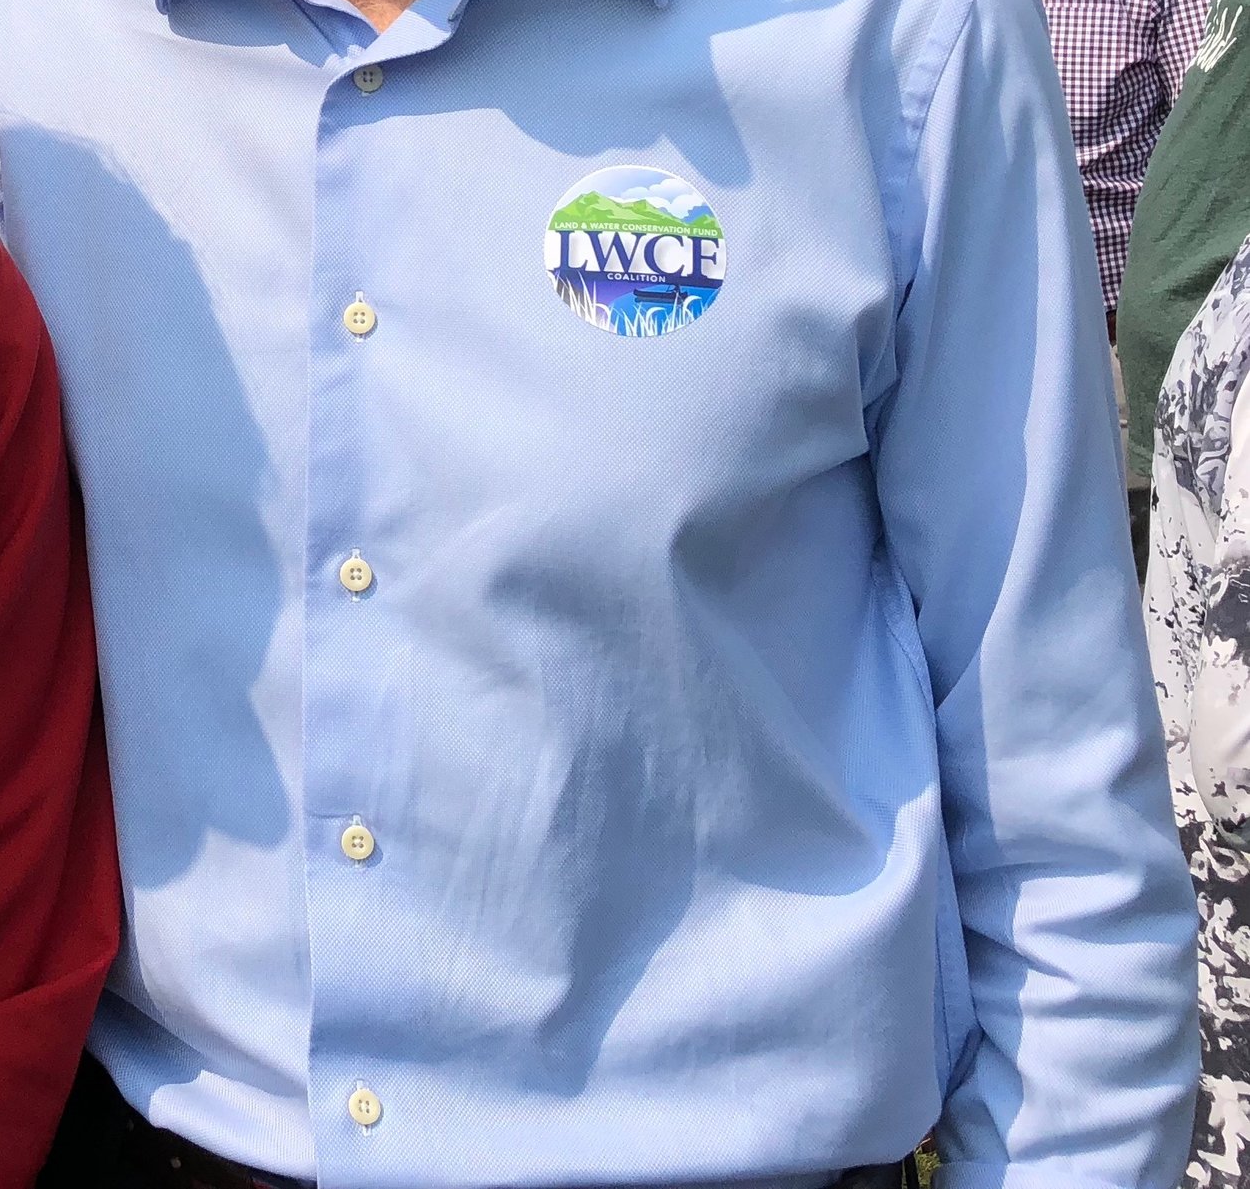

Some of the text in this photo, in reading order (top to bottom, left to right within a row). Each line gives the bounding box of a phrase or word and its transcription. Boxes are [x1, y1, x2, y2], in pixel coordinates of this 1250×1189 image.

[554, 221, 718, 237] LAND & WATER CONSERVATION FUND
[553, 230, 720, 280] LWCF
[607, 272, 666, 283] COALITION
